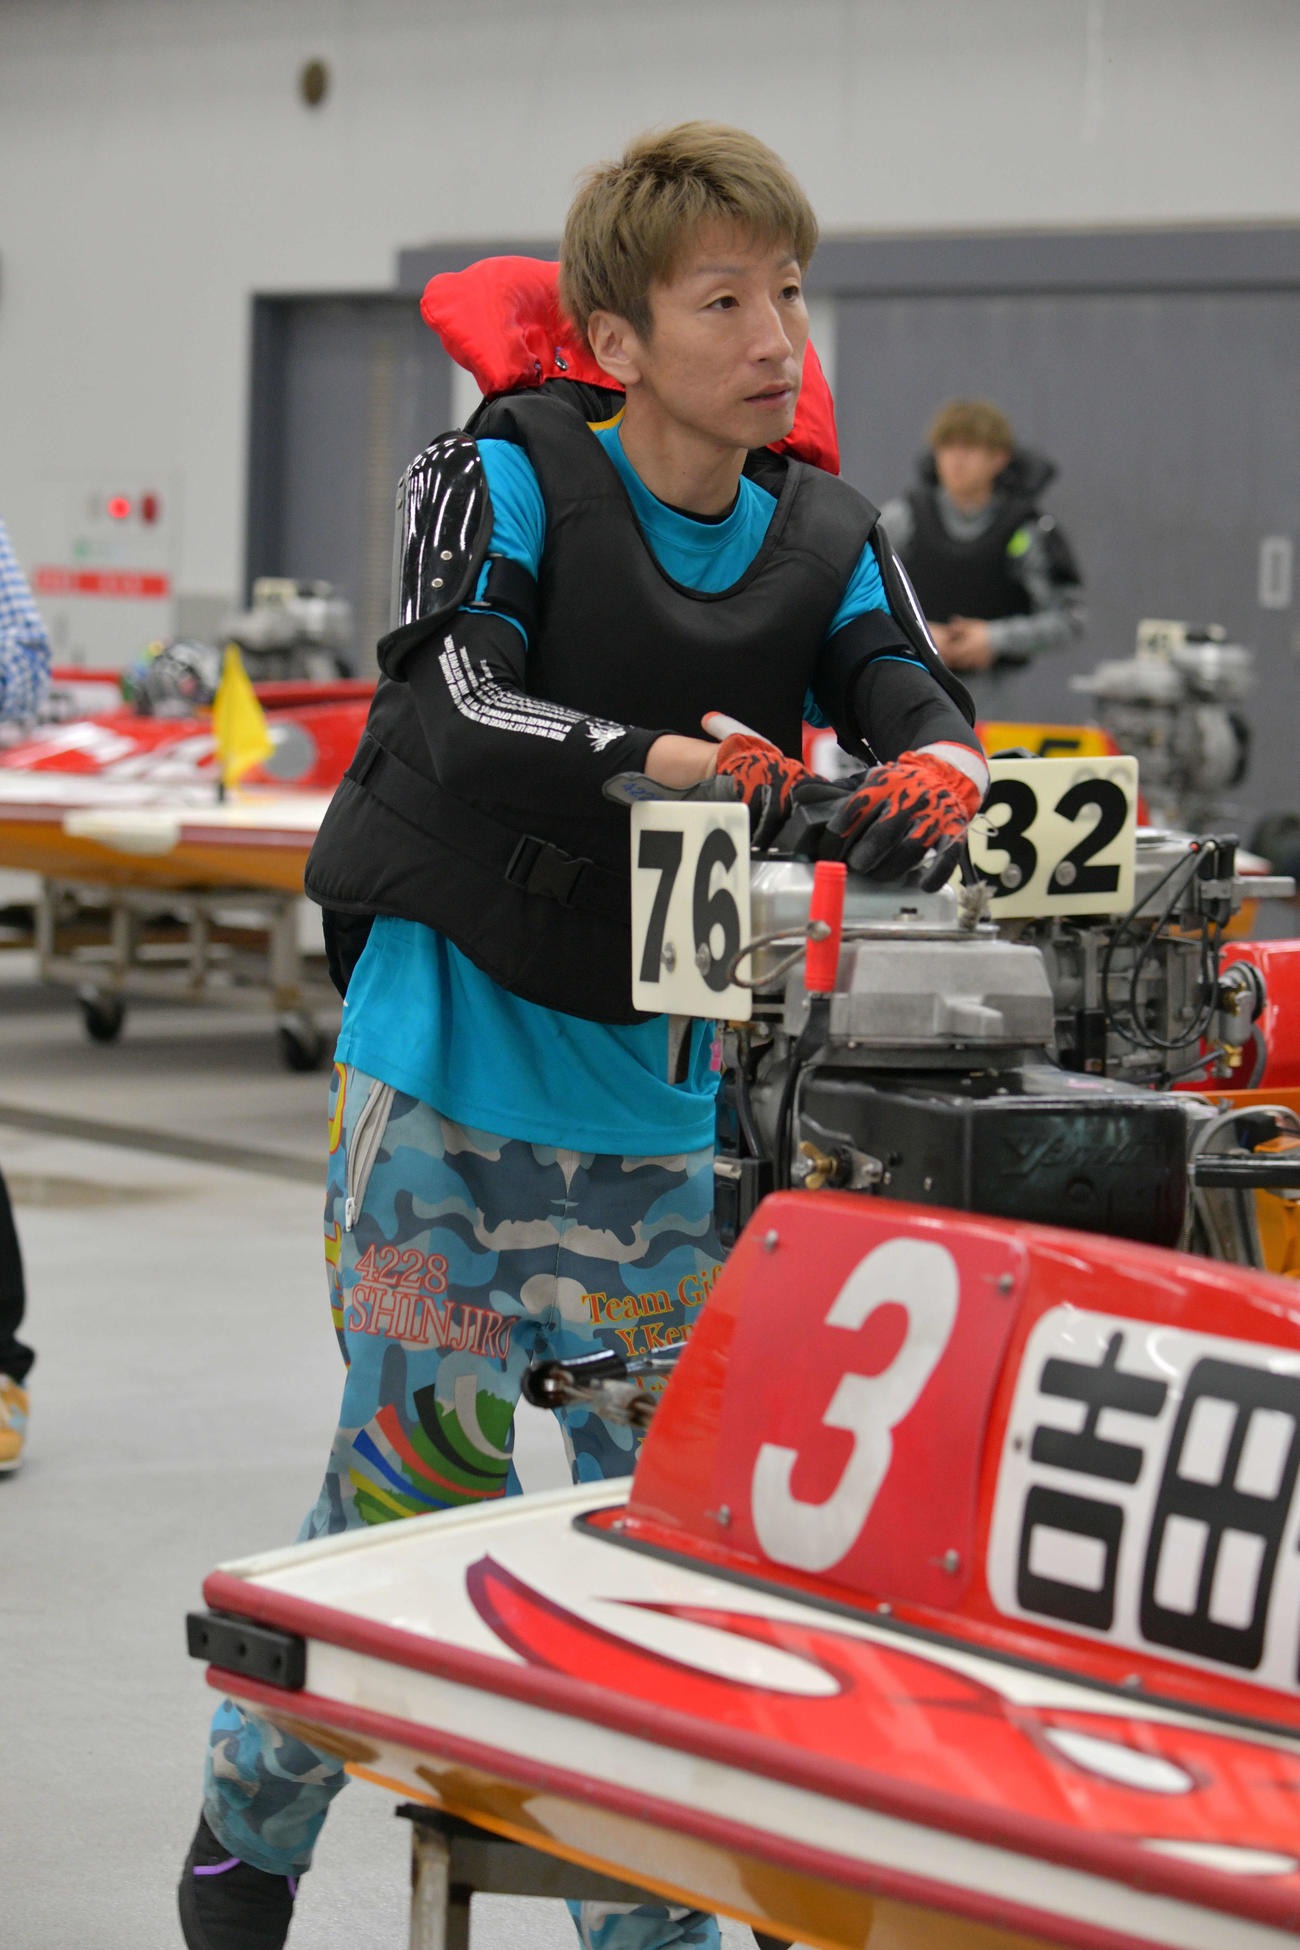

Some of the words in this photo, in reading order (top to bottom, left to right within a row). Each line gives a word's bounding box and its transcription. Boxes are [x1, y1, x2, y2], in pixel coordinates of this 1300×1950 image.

[623, 783, 664, 801] 422
[960, 778, 1128, 899] 32
[638, 828, 741, 993] 76
[355, 1243, 449, 1295] 4228
[581, 1289, 675, 1326] Team
[348, 1283, 519, 1361] SHINJIRO
[751, 1237, 960, 1572] 3
[1014, 1330, 1300, 1675] 吉田
